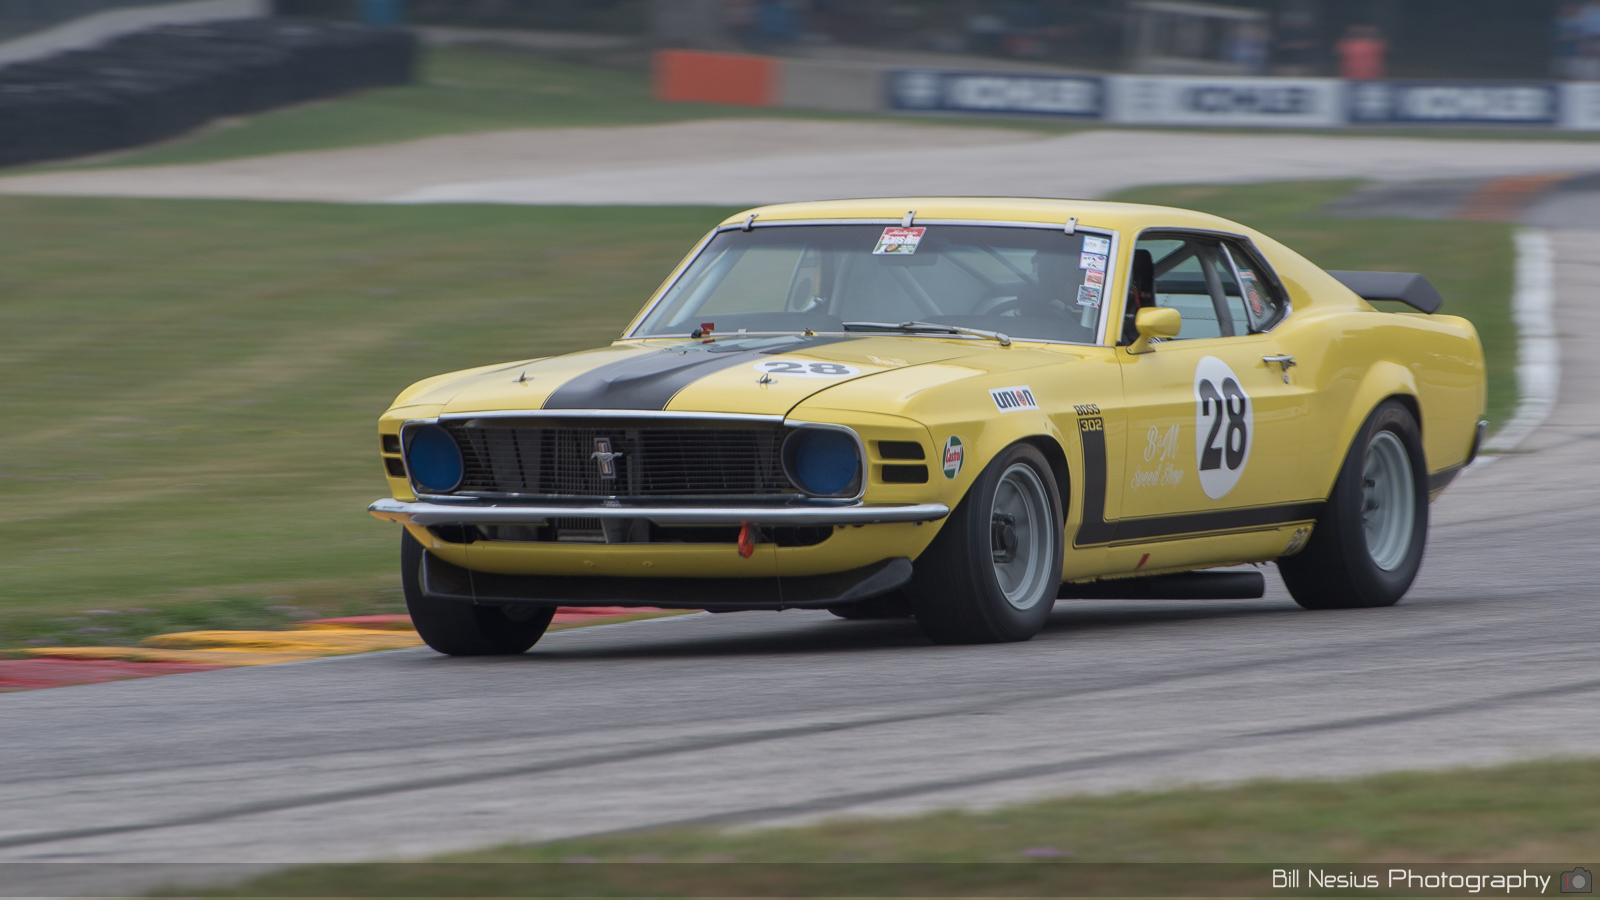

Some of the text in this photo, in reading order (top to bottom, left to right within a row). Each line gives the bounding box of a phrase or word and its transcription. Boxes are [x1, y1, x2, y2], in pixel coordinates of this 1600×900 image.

[765, 361, 850, 374] 28
[1073, 404, 1100, 416] BOSS
[1081, 419, 1103, 432] 302
[1199, 376, 1247, 471] 28
[946, 446, 962, 463] Castrol
[1131, 462, 1184, 493] Speed Shop
